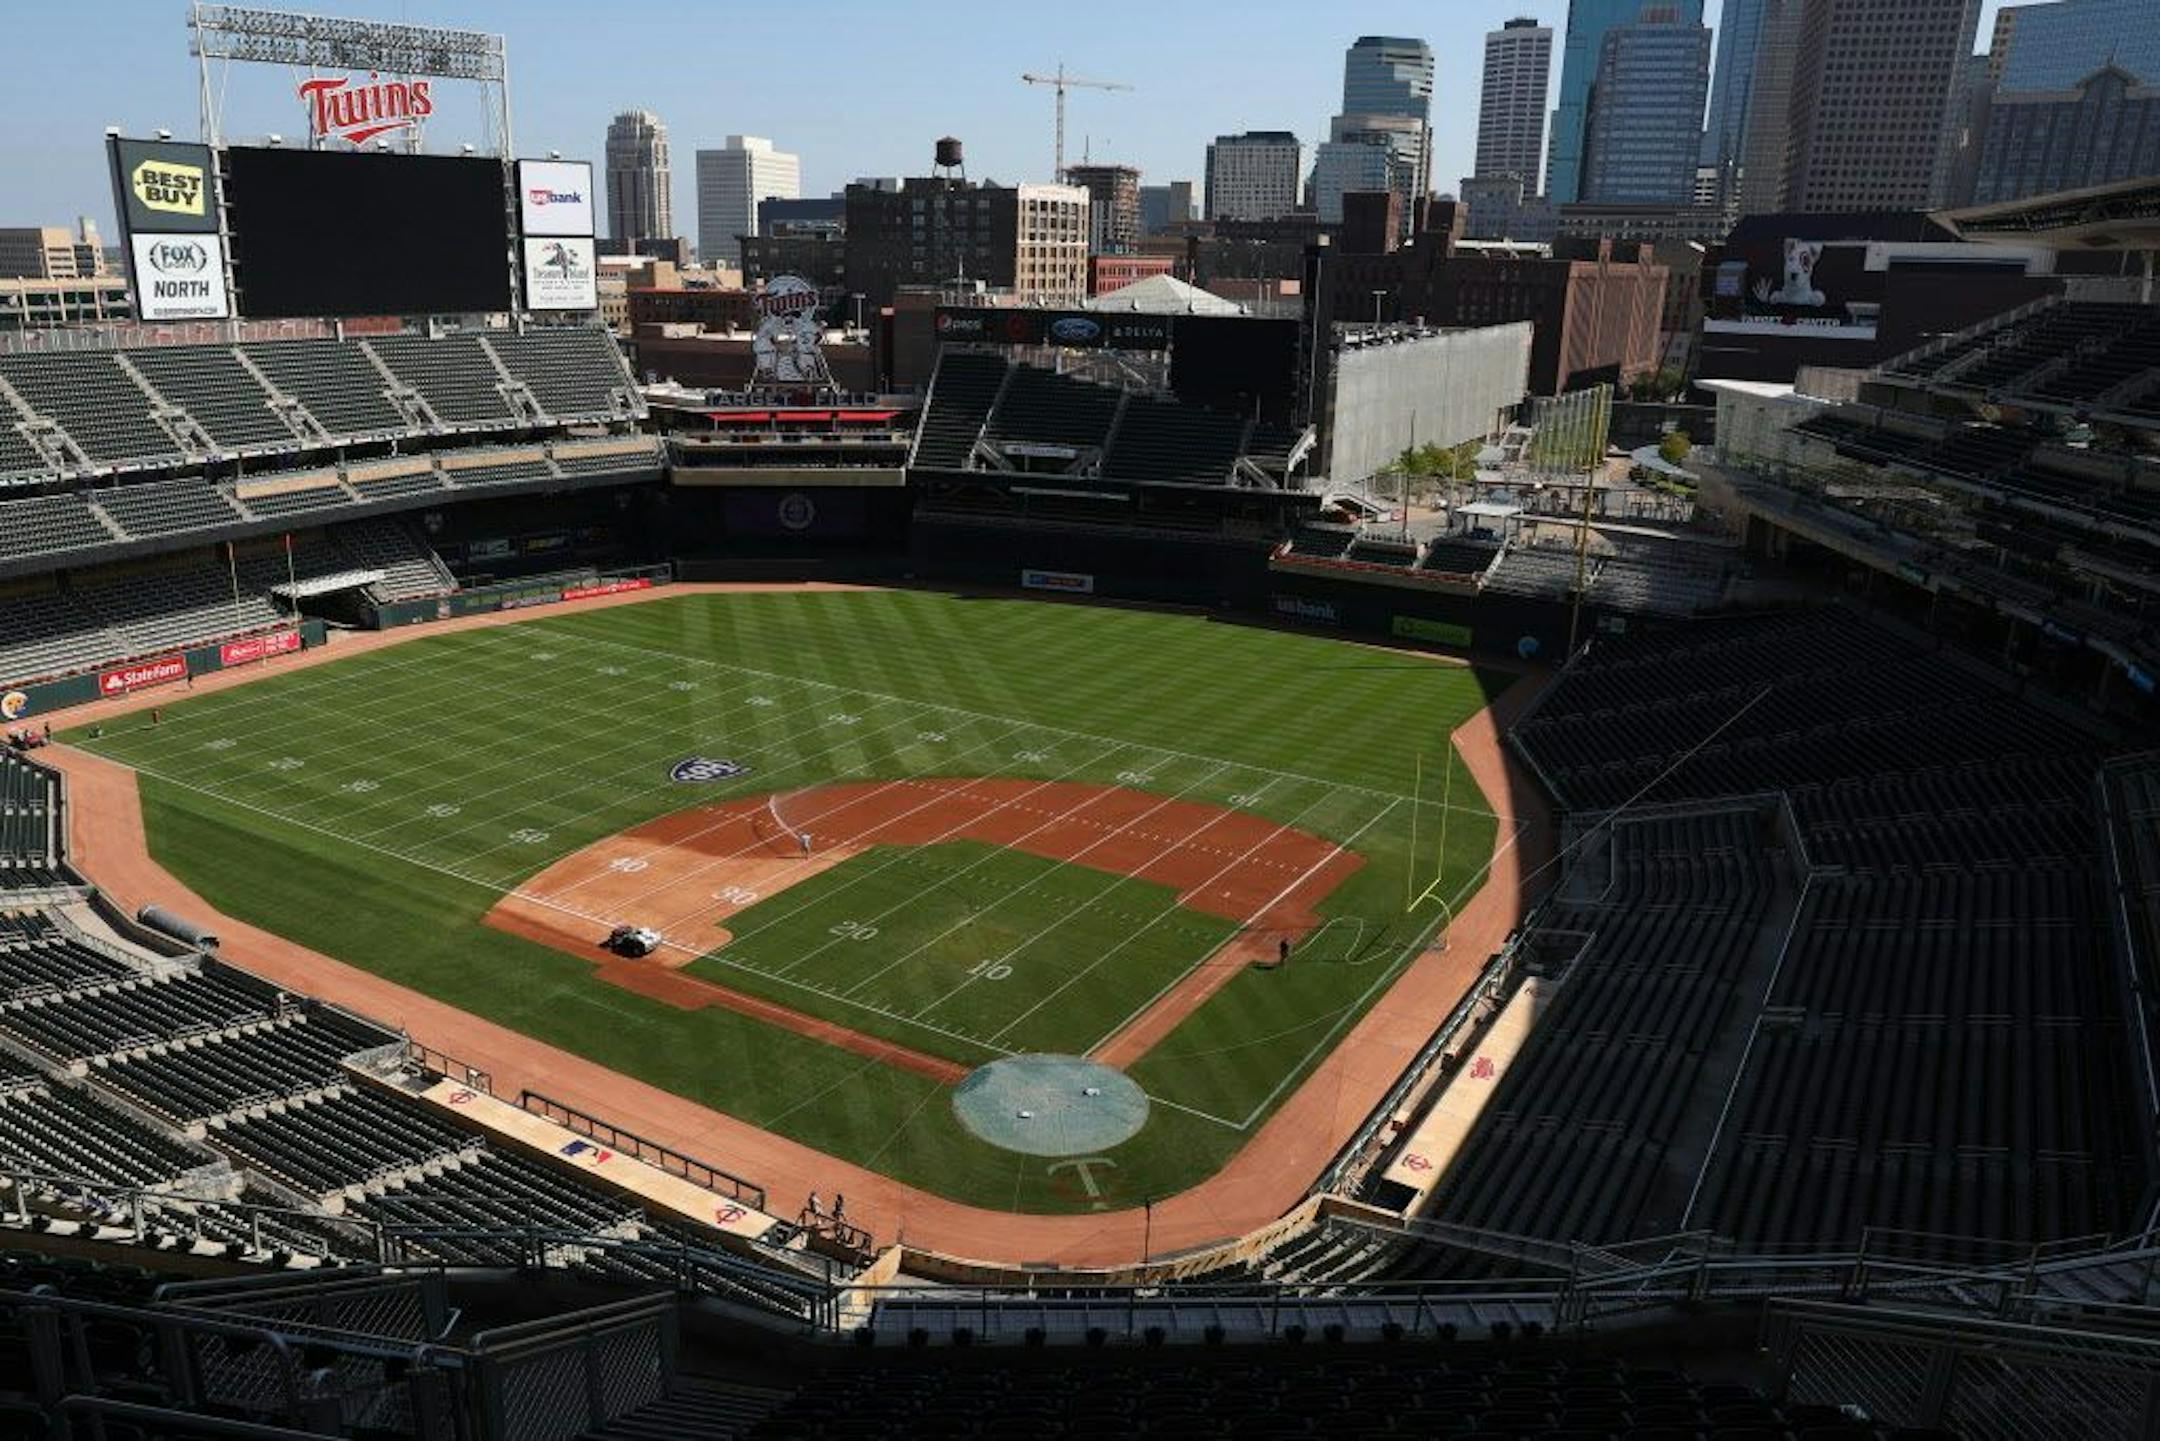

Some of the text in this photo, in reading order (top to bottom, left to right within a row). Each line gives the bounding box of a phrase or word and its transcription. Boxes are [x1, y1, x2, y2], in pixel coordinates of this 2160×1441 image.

[299, 71, 432, 136] Twins
[142, 169, 201, 191] BEST
[145, 186, 197, 206] BUY
[160, 244, 196, 264] FOX
[154, 280, 209, 298] NORTH
[1125, 326, 1163, 337] DELTA
[707, 391, 878, 406] TARGET FIELD
[828, 920, 879, 941] 20
[966, 959, 1012, 980] 10
